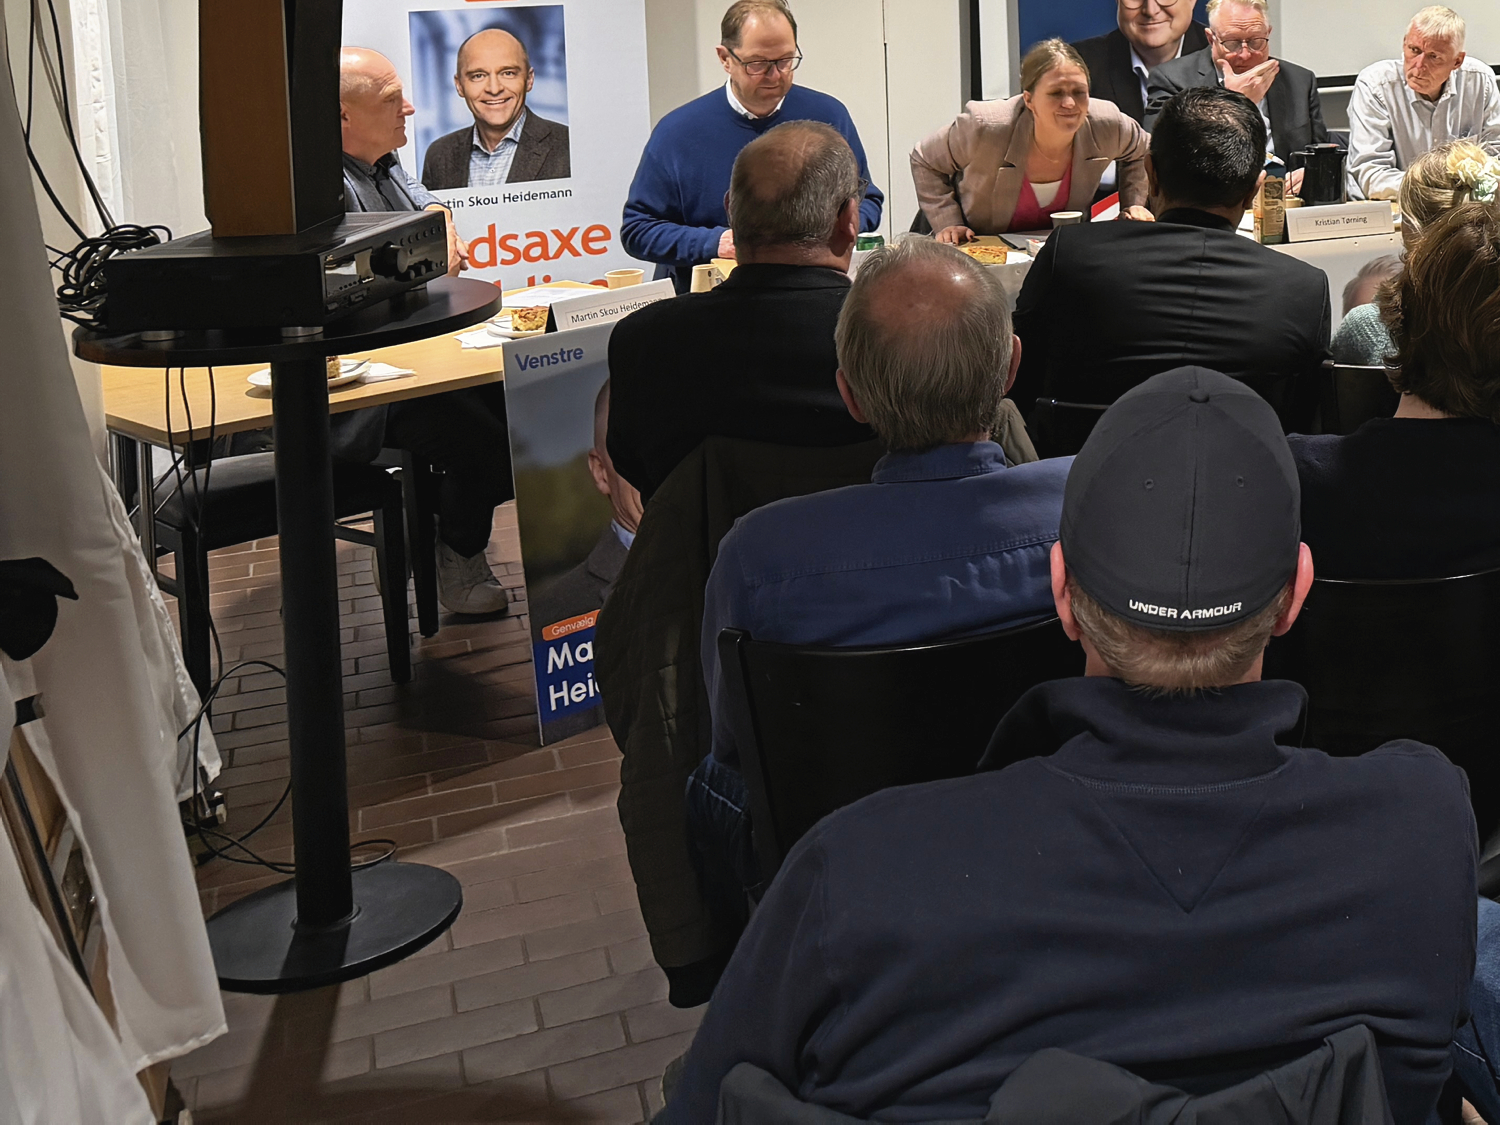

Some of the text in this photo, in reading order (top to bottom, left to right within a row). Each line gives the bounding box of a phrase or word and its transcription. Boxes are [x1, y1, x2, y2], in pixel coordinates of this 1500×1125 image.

[468, 195, 498, 207] Skou
[502, 188, 573, 204] Heidemann
[1314, 216, 1368, 227] Kristian Tørning
[467, 222, 611, 269] dsaxe
[571, 310, 599, 324] Martin
[599, 305, 619, 318] Skou
[514, 346, 584, 372] Venstre
[1128, 599, 1243, 620] UNDER ARMOUR
[551, 616, 594, 636] Genvælg
